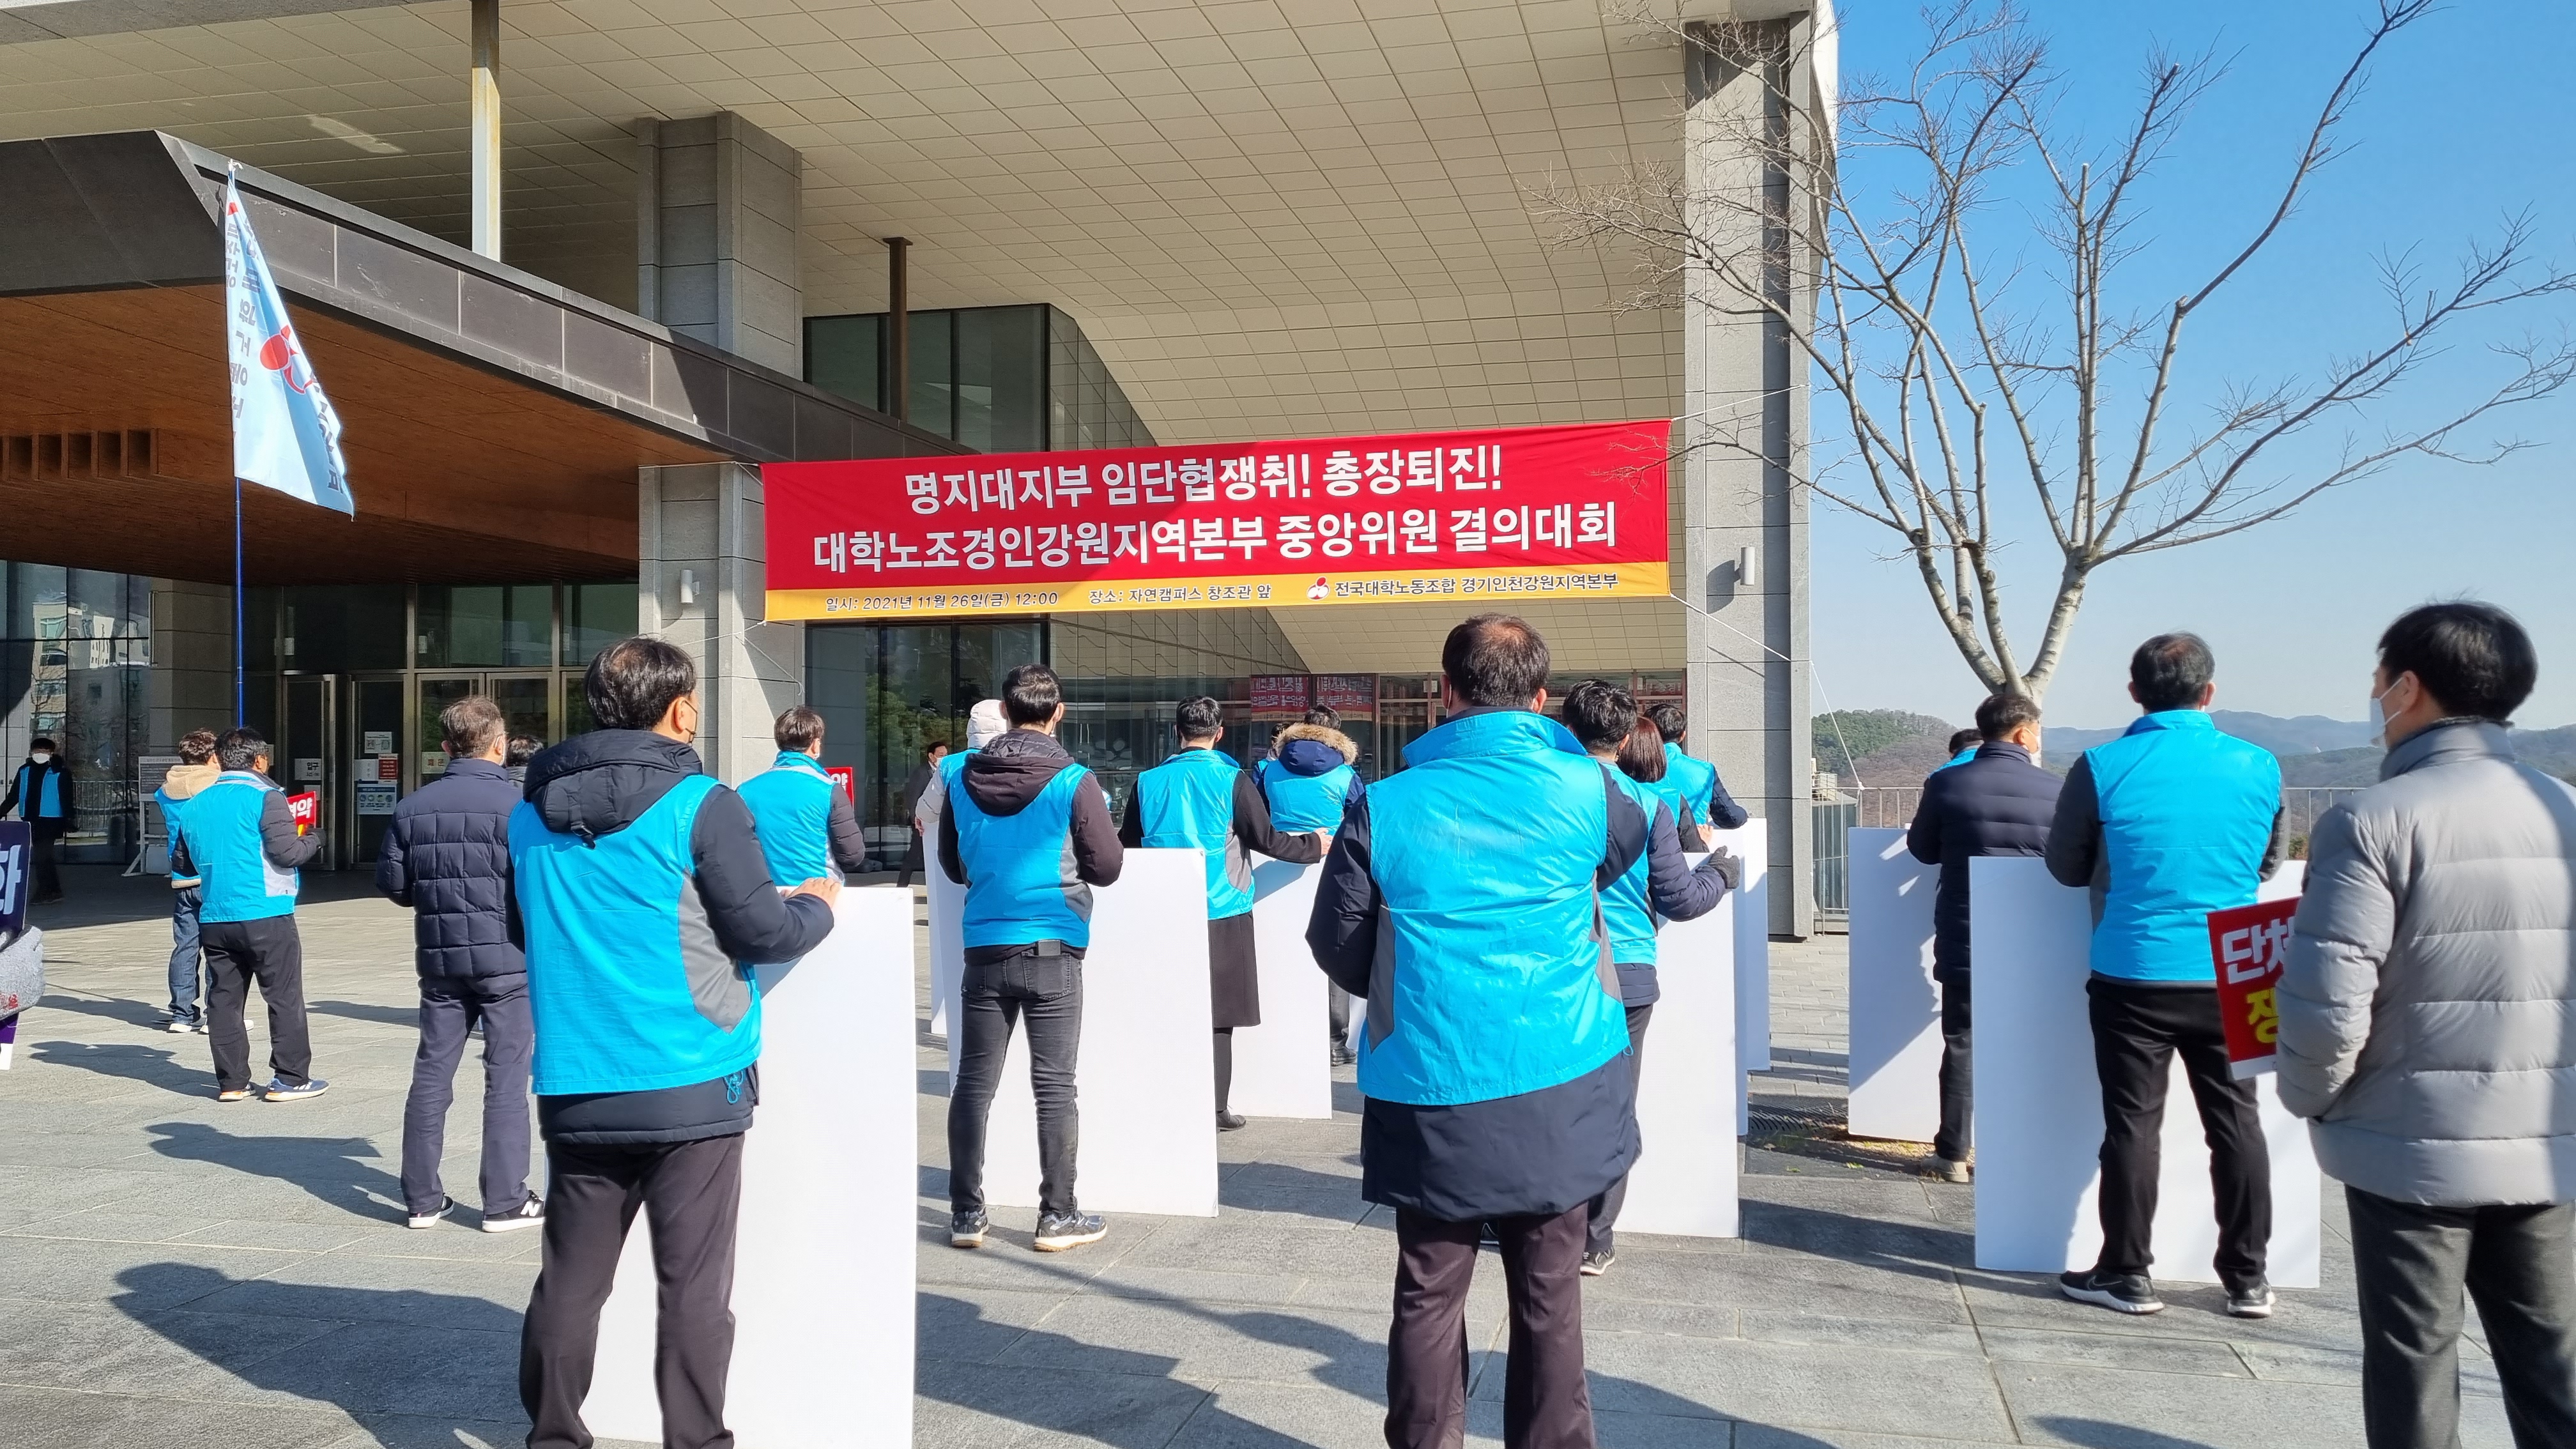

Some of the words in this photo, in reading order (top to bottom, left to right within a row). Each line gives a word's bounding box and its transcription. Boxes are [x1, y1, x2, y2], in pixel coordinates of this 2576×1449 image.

[905, 464, 1092, 515] 명지대지부
[1101, 454, 1311, 505] 임단협쟁취!
[1322, 445, 1501, 496] 총장퇴진!
[814, 515, 1268, 573] 대학노조경인강원지역본부
[1276, 509, 1438, 559] 중앙위원
[1450, 501, 1615, 553] 결의대회
[1089, 589, 1123, 604] 장소:
[1129, 586, 1202, 602] 자연캠퍼스
[1208, 585, 1252, 600] 창조관
[1257, 584, 1271, 599] 앞
[1335, 578, 1456, 597] 전국대학노동조합
[1461, 573, 1618, 593] 경기인천강원지역본부
[826, 597, 859, 611] 일시:
[863, 595, 912, 610] 2021년
[917, 594, 946, 608] 11월
[951, 592, 1011, 608] 26일(금)
[1015, 593, 1058, 606] 12:00
